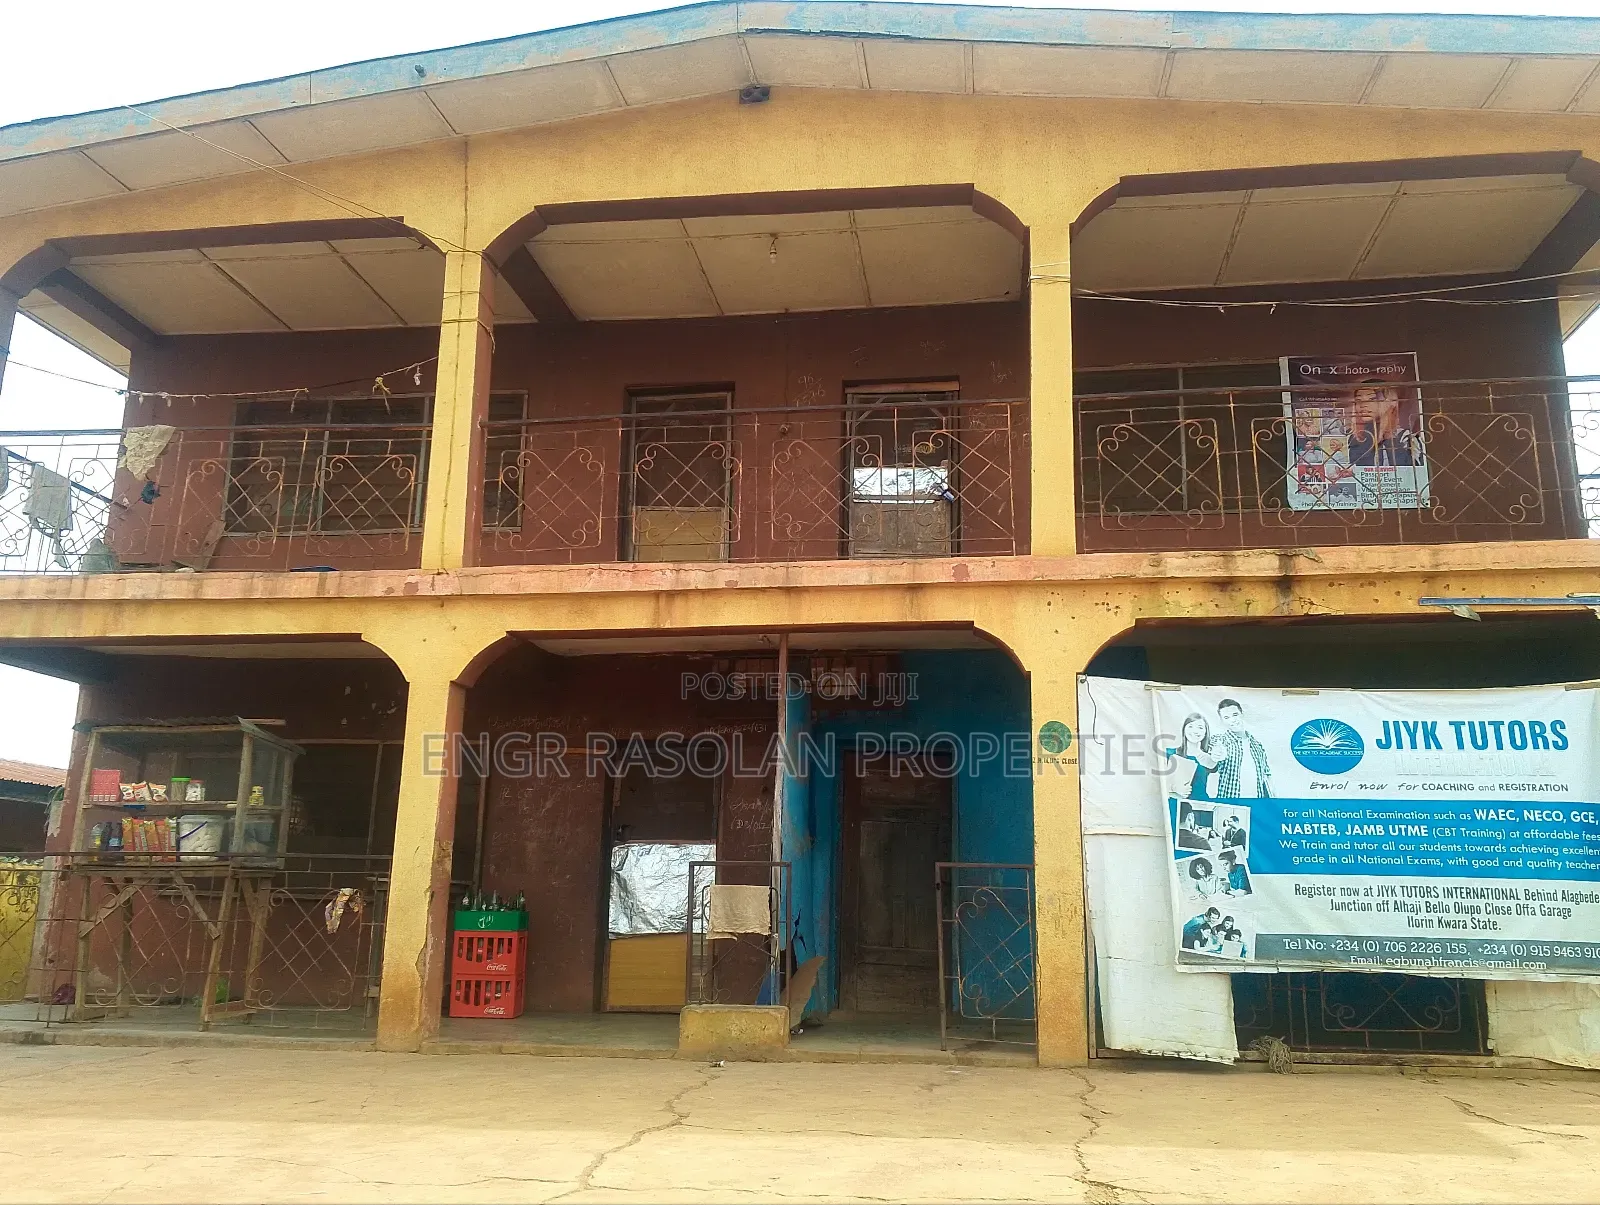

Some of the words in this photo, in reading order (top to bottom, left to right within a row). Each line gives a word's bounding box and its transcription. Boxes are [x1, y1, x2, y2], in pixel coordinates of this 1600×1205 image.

[1376, 720, 1443, 750] JIYK
[1448, 719, 1569, 751] TUTORS
[1310, 781, 1348, 790] Enrol
[1398, 782, 1420, 791] for
[1422, 783, 1475, 792] COACHING
[1479, 783, 1496, 792] and
[1498, 783, 1569, 792] REGISTRATION
[1283, 809, 1298, 818] for
[1302, 809, 1314, 818] all
[1318, 809, 1364, 819] National
[1366, 810, 1430, 820] Examination
[1434, 811, 1456, 820] such
[1474, 809, 1520, 822] WAEC,
[1524, 810, 1567, 824] NECO,
[1570, 811, 1599, 825] GCE,
[1281, 824, 1341, 836] NABTEB,
[1345, 824, 1385, 836] JAMB
[1388, 825, 1429, 837] UTME
[1432, 828, 1456, 838] (CBT
[1460, 828, 1506, 840] Training)
[1510, 830, 1520, 838] at
[1524, 829, 1580, 840] affordable
[1279, 840, 1298, 849] We
[1301, 840, 1326, 850] Train
[1330, 841, 1350, 850] and
[1354, 842, 1378, 850] tutor
[1382, 841, 1396, 850] all
[1419, 842, 1461, 852] students
[1464, 844, 1506, 853] towards
[1510, 844, 1559, 856] achieving
[1292, 854, 1325, 865] grade
[1328, 854, 1338, 863] in
[1341, 854, 1354, 864] all
[1358, 855, 1404, 864] National
[1407, 856, 1443, 867] Exams,
[1447, 857, 1468, 866] with
[1472, 857, 1499, 868] good
[1503, 858, 1523, 867] and
[1527, 858, 1562, 870] quality
[1294, 884, 1336, 898] Register
[1340, 886, 1359, 897] now
[1363, 886, 1374, 897] at
[1377, 885, 1397, 898] JIYK
[1400, 886, 1439, 899] TUTORS
[1442, 886, 1521, 900] INTERNATIONAL
[1524, 889, 1558, 902] Behind
[1561, 890, 1600, 905] Alagbede
[1330, 899, 1372, 912] Junction
[1376, 900, 1389, 912] off
[1393, 900, 1422, 915] Alhaji
[1426, 901, 1450, 914] Bello
[1454, 902, 1481, 917] Olupo
[1484, 902, 1512, 916] Close
[1516, 904, 1536, 916] Offa
[1540, 904, 1572, 919] Garage
[1438, 917, 1467, 929] Kwara
[1470, 917, 1502, 930] State.
[1283, 938, 1302, 950] Tel
[1306, 939, 1327, 950] No:
[1330, 940, 1359, 951] +234
[1362, 940, 1380, 952] (0)
[1384, 942, 1407, 952] 706
[1410, 942, 1441, 953] 2226
[1446, 944, 1470, 956] 155,
[1477, 944, 1507, 955] +234
[1510, 944, 1526, 956] (0)
[1530, 945, 1550, 956] 915
[1553, 946, 1582, 958] 9463
[486, 963, 508, 971] Coca-Cola
[1350, 956, 1382, 966] Email:
[1385, 956, 1546, 970] egbunahfrancis@gmail.com
